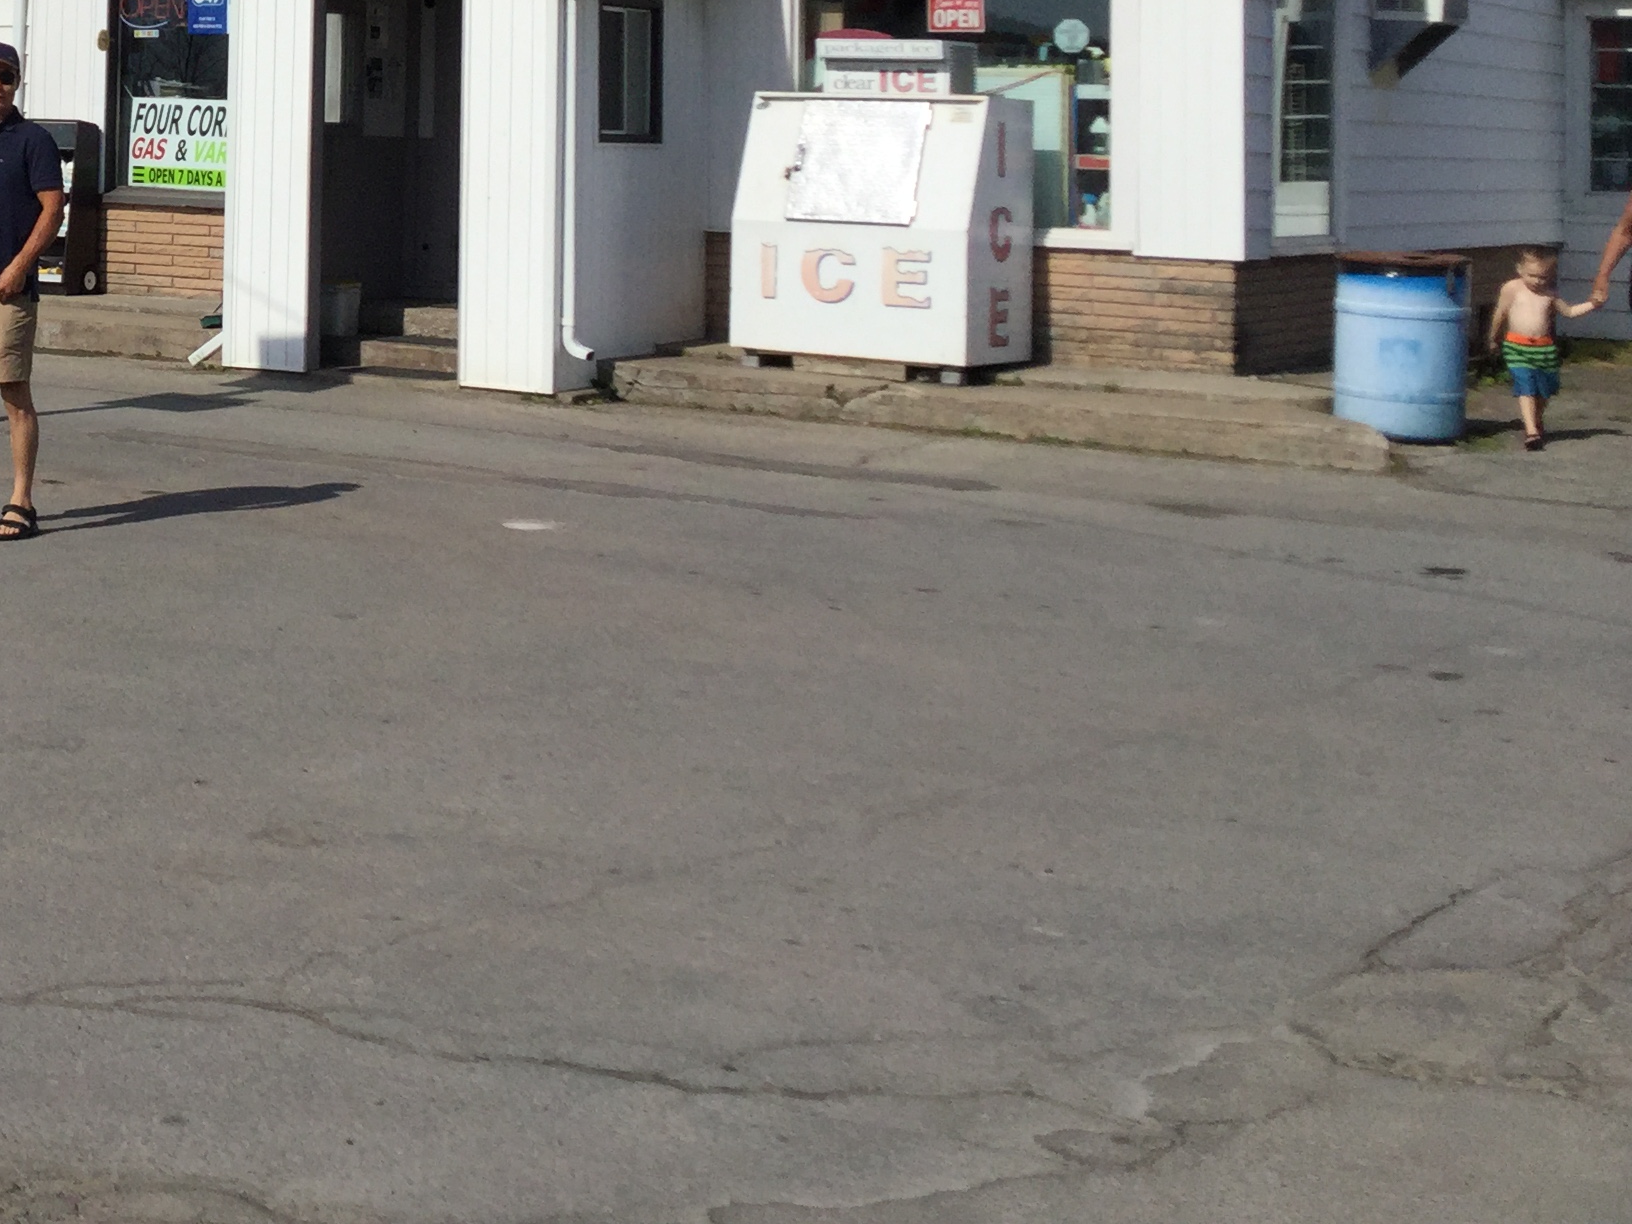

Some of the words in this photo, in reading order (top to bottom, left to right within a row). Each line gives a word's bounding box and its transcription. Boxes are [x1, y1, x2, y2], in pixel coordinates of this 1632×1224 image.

[933, 9, 980, 28] OPEN
[824, 42, 904, 56] packaged
[833, 75, 875, 91] clear
[879, 69, 938, 93] ICE
[132, 103, 183, 135] FOUR
[187, 104, 227, 137] COR
[131, 136, 168, 160] GAS
[175, 139, 188, 162] &
[148, 167, 175, 184] OPEN
[178, 169, 184, 184] 7
[187, 170, 213, 186] DAYS
[215, 171, 223, 187] A
[760, 241, 932, 310] ICE
